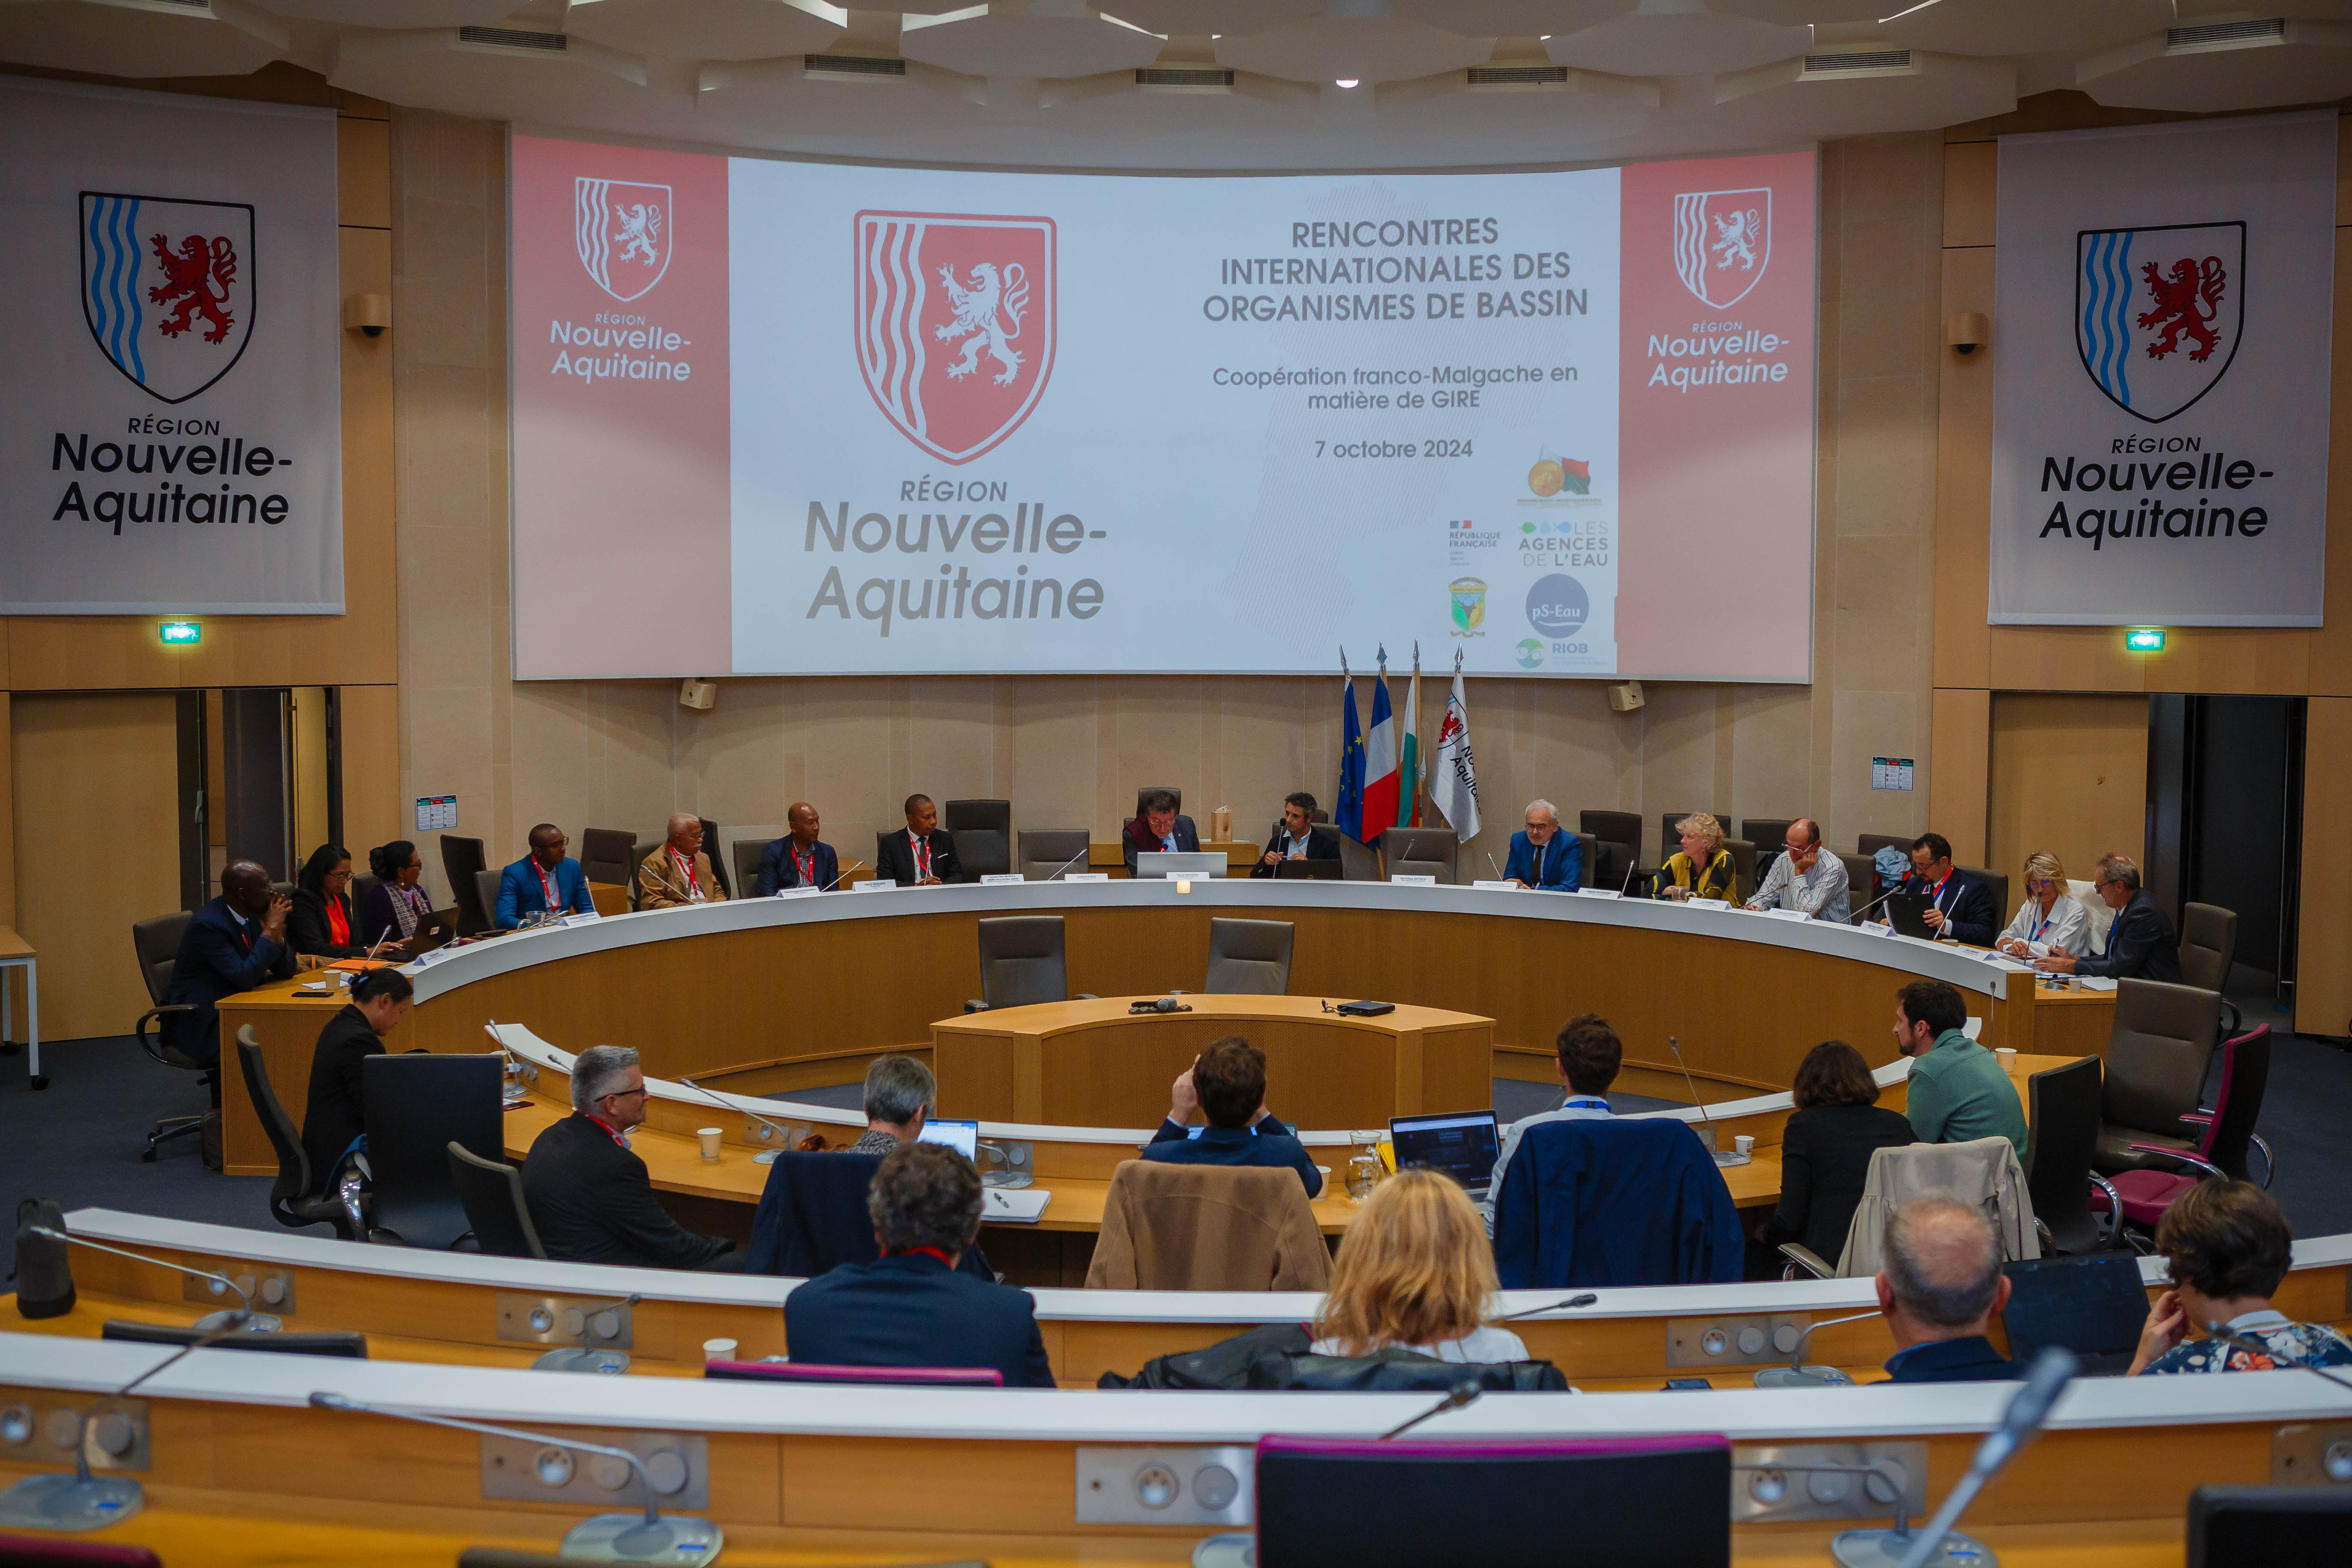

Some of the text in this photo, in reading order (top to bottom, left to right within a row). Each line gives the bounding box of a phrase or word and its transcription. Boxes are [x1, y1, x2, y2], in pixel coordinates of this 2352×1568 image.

[1292, 217, 1499, 248] RENCONTRES
[1221, 251, 1571, 285] INTERNATIONALES DES
[1203, 288, 1588, 321] ORGANISMES DE BASSIN
[595, 311, 645, 326] RÉGION
[1692, 321, 1742, 332] RÉGION
[550, 320, 691, 351] Nouvelle-
[1648, 330, 1789, 357] Nouvelle-
[551, 351, 691, 384] Aquitaine
[1213, 364, 1577, 389] Coopération franco-Malgache en
[1648, 358, 1787, 393] Aquitaine
[1308, 390, 1480, 409] matière de GIRE
[127, 414, 220, 436] RÉGION
[52, 433, 292, 476] Nouvelle-
[1315, 440, 1473, 458] 7 octobre 2024
[2112, 434, 2201, 454] RÉGION
[2041, 453, 2274, 492] Nouvelle-
[901, 474, 1007, 502] RÉGION
[53, 481, 289, 535] Aquitaine
[804, 501, 1107, 553] Nouvelle-
[1449, 531, 1500, 540] RÉPUBLIQUE
[1574, 521, 1608, 535] LES
[2039, 498, 2268, 551] Aquitaine
[1449, 540, 1497, 549] FRANÇAISE
[1519, 538, 1608, 550] AGENCES
[1523, 554, 1546, 566] DE
[805, 563, 1104, 637] Aquitaine
[1532, 604, 1580, 620] pS-Eau
[1552, 643, 1588, 654] RIOB
